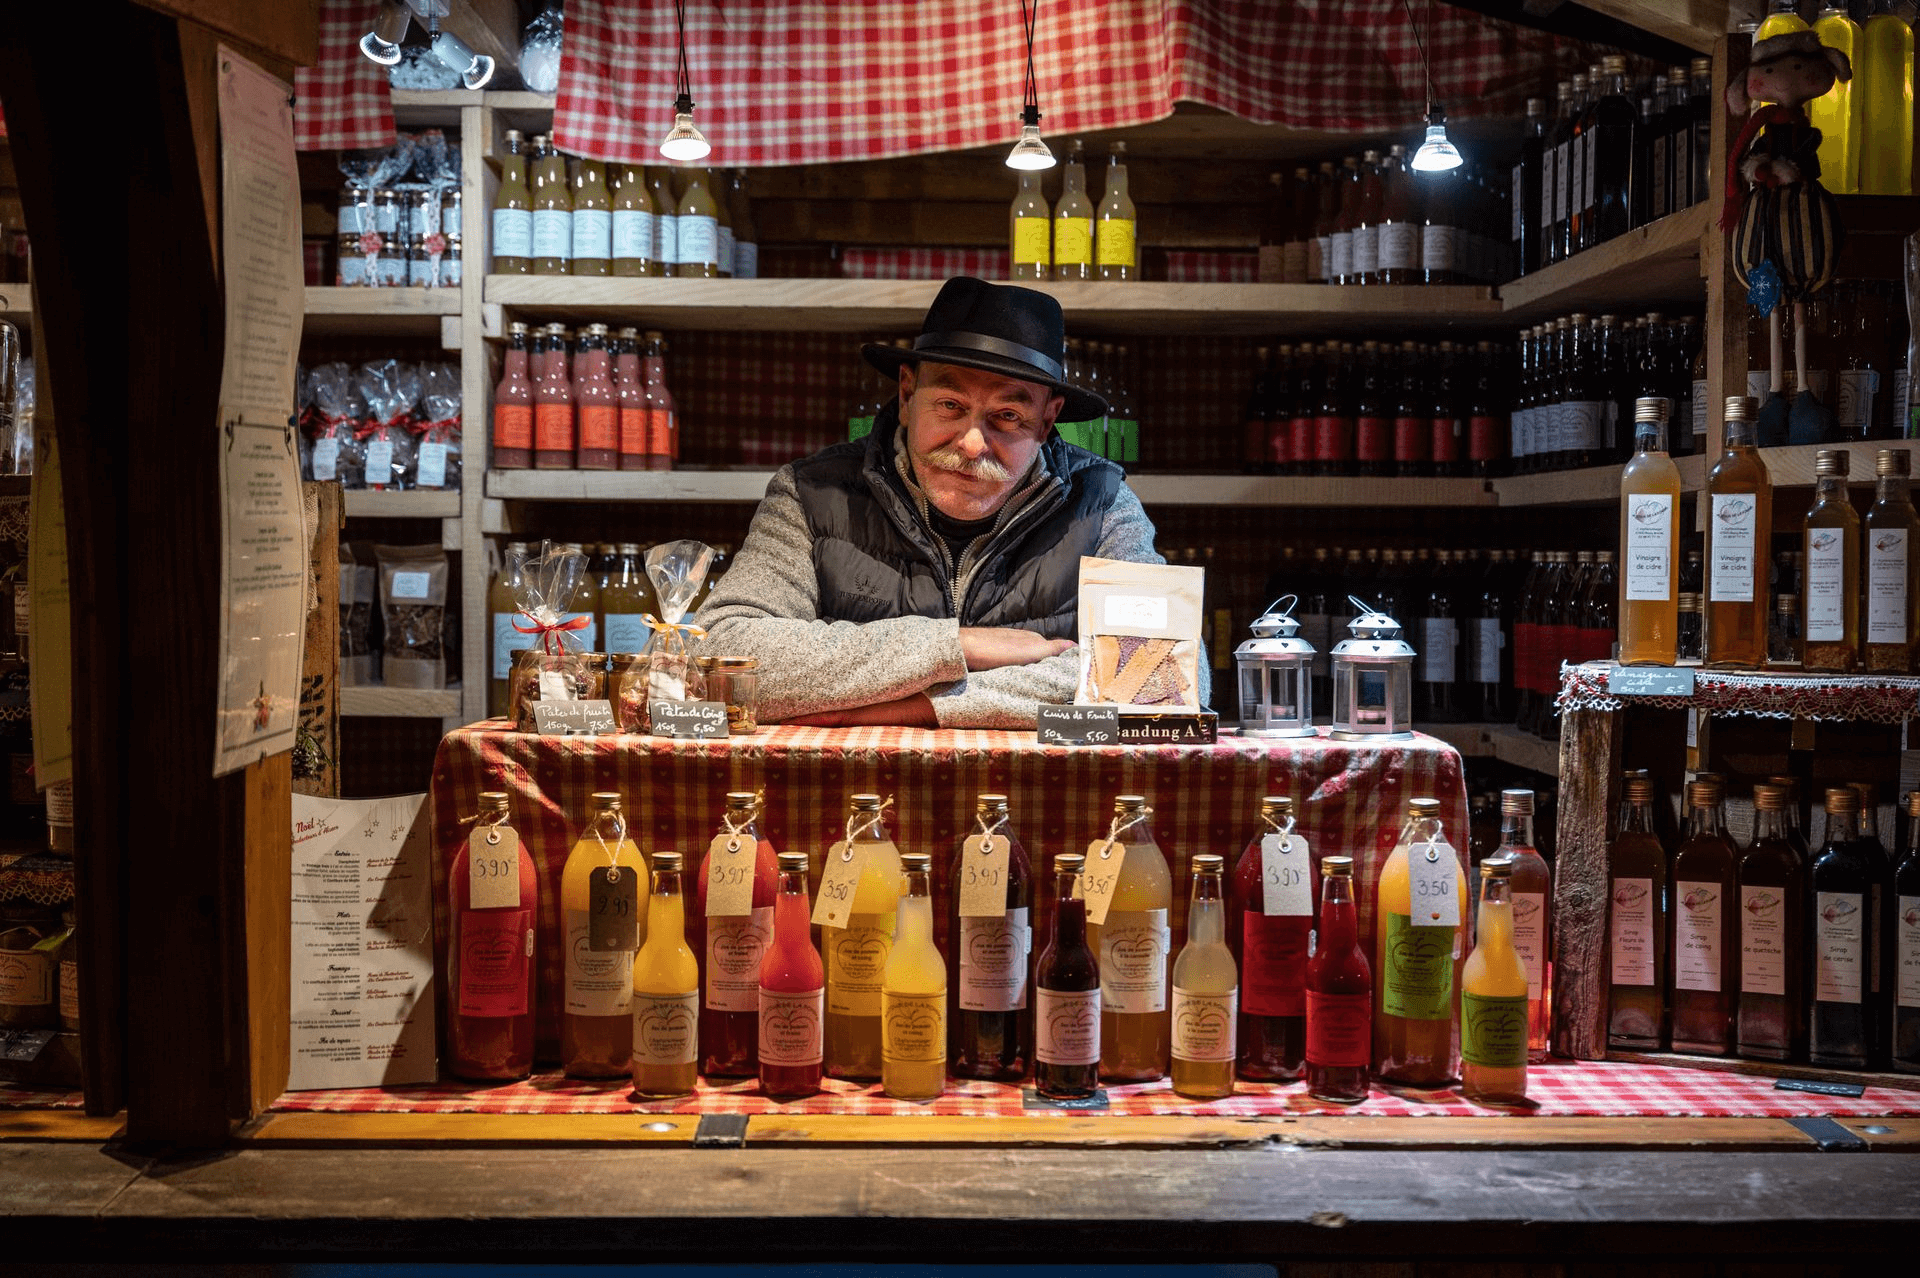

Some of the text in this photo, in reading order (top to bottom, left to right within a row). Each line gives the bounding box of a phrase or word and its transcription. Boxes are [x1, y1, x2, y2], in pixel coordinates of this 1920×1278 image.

[1720, 554, 1746, 563] Vinaigre
[840, 590, 856, 600] JUST
[1043, 709, 1114, 720] Cuirs de Fruits
[1117, 725, 1180, 741] andung
[296, 817, 315, 833] Noël
